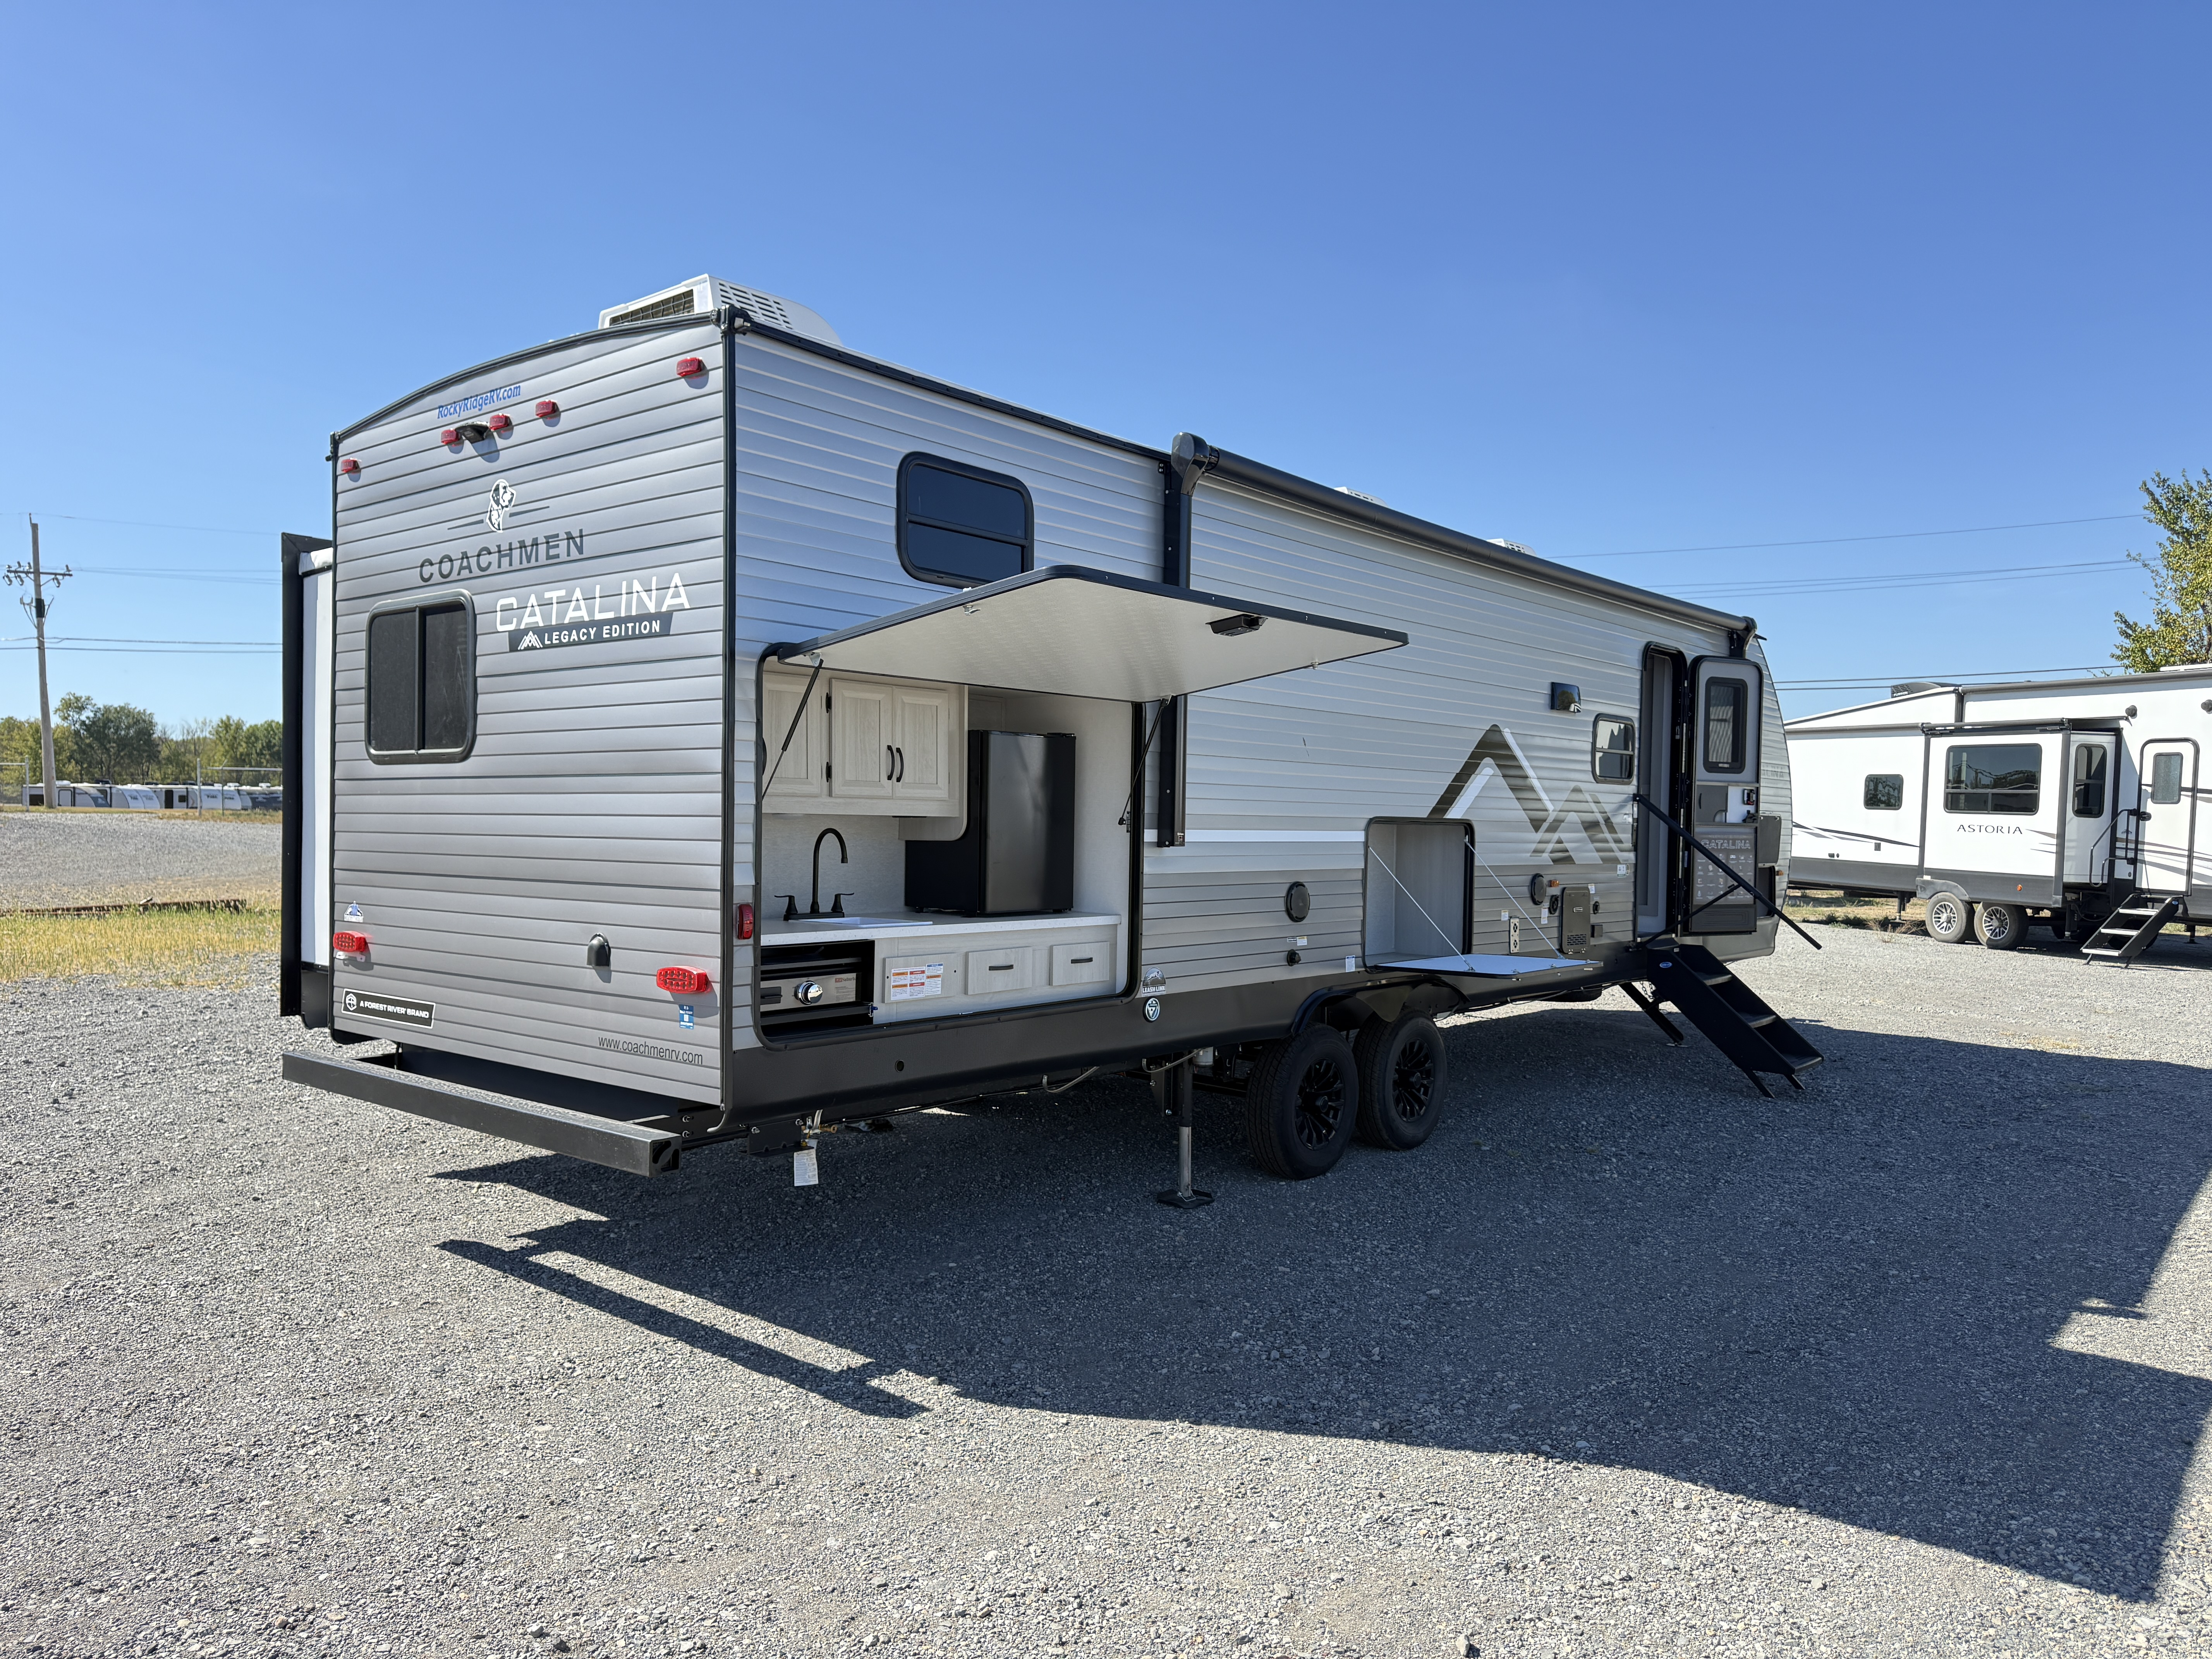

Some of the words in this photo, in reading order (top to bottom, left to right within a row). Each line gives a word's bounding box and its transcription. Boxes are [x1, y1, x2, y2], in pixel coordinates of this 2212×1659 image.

[437, 385, 520, 419] RockyRidgeRV.com
[419, 528, 584, 582] COACHMEN
[496, 572, 690, 632] CATALINA
[544, 627, 597, 645] LEGACY
[603, 620, 660, 638] EDITION
[1957, 824, 2023, 834] ASTORIA
[1701, 840, 1751, 849] CATALINA
[364, 1001, 387, 1011] FOREST
[407, 1008, 429, 1018] BRAND
[598, 1037, 703, 1065] www.coachmenrv.com
